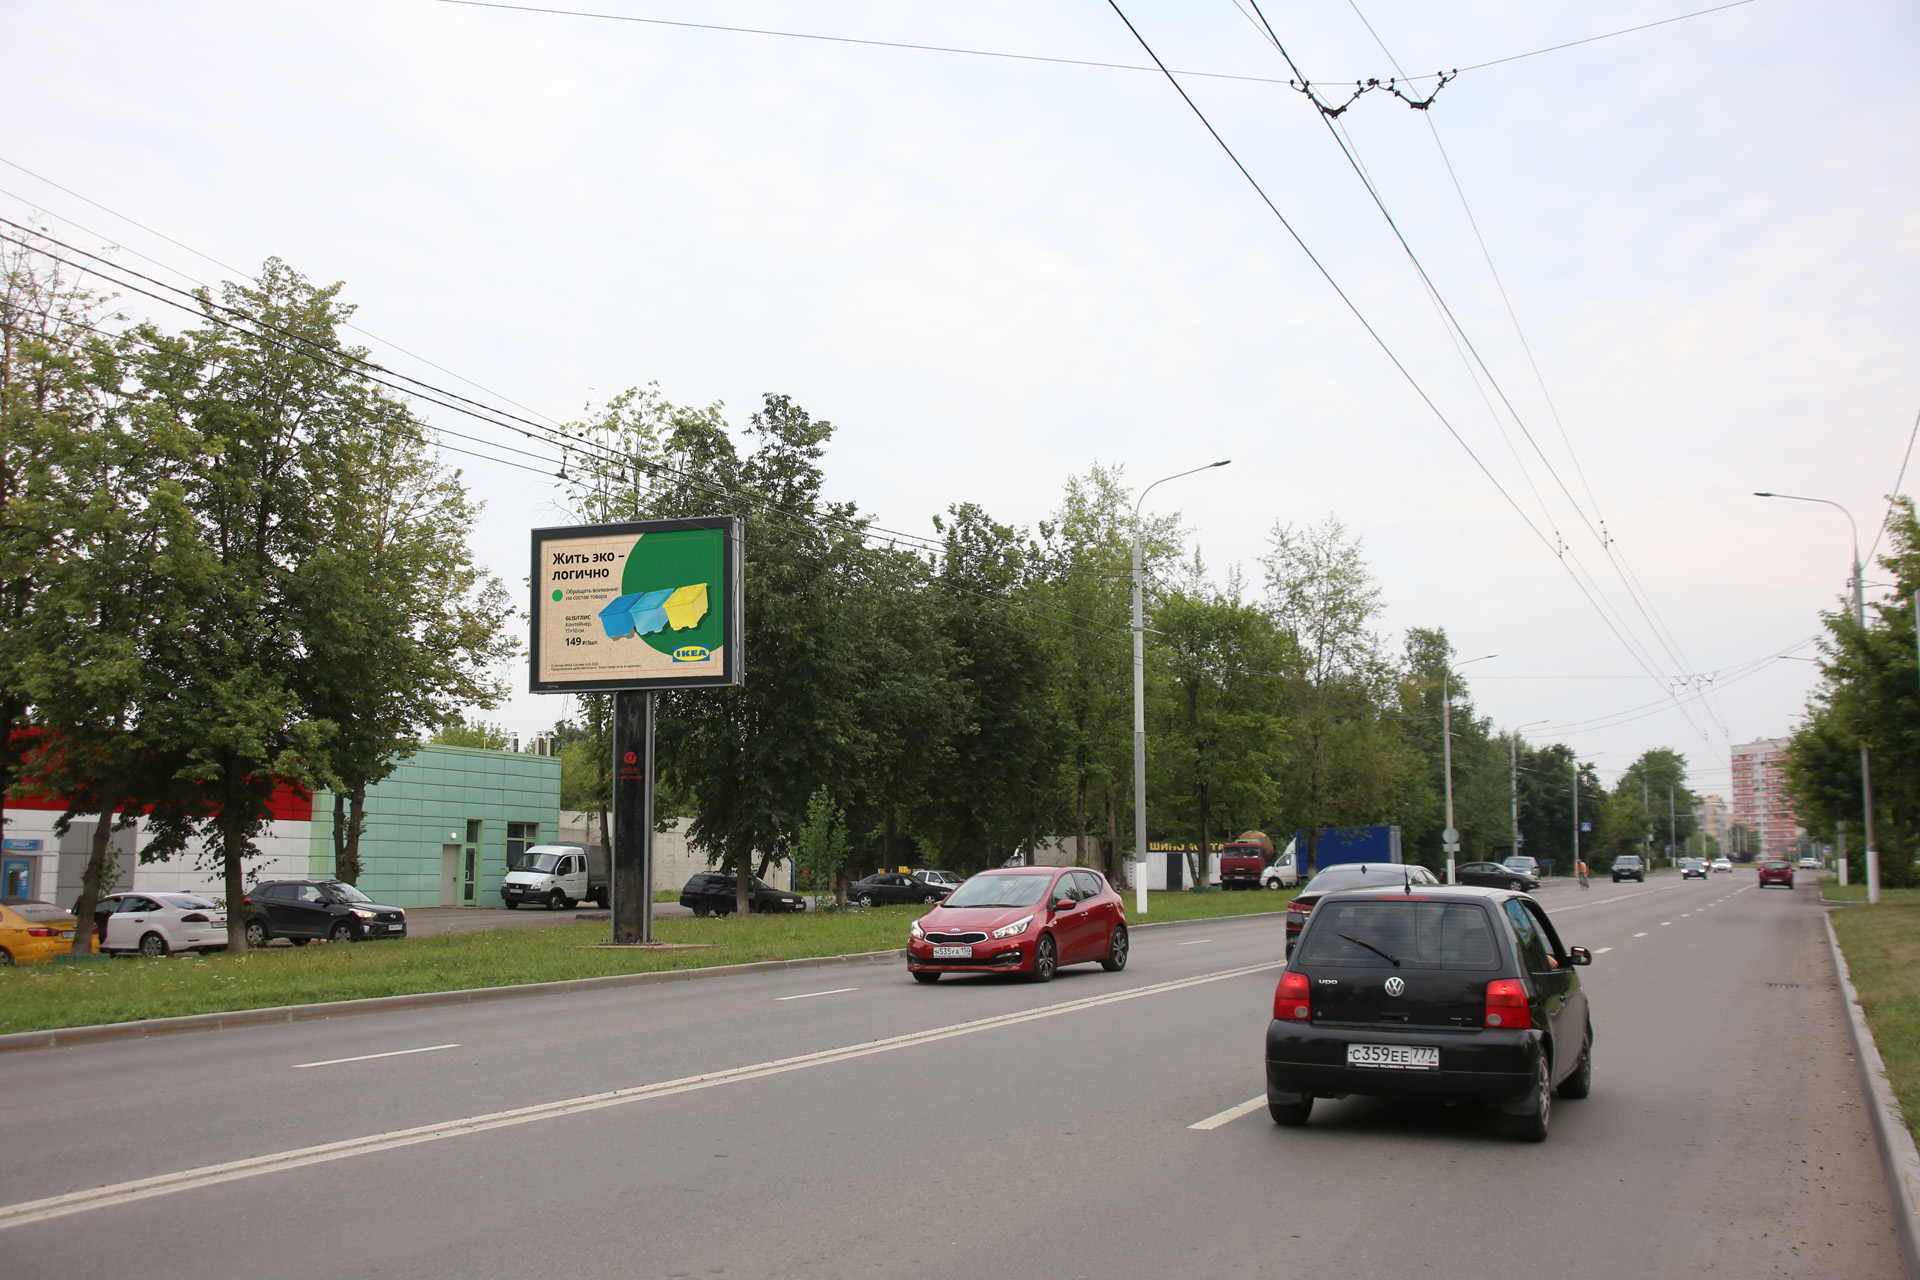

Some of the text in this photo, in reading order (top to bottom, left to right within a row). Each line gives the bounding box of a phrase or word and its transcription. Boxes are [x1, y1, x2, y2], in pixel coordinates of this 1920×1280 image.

[552, 552, 590, 565] Жить
[592, 551, 615, 563] эко
[552, 568, 610, 581] логично
[565, 636, 582, 647] 149
[676, 649, 707, 658] IKEA
[1412, 1047, 1435, 1060] 777
